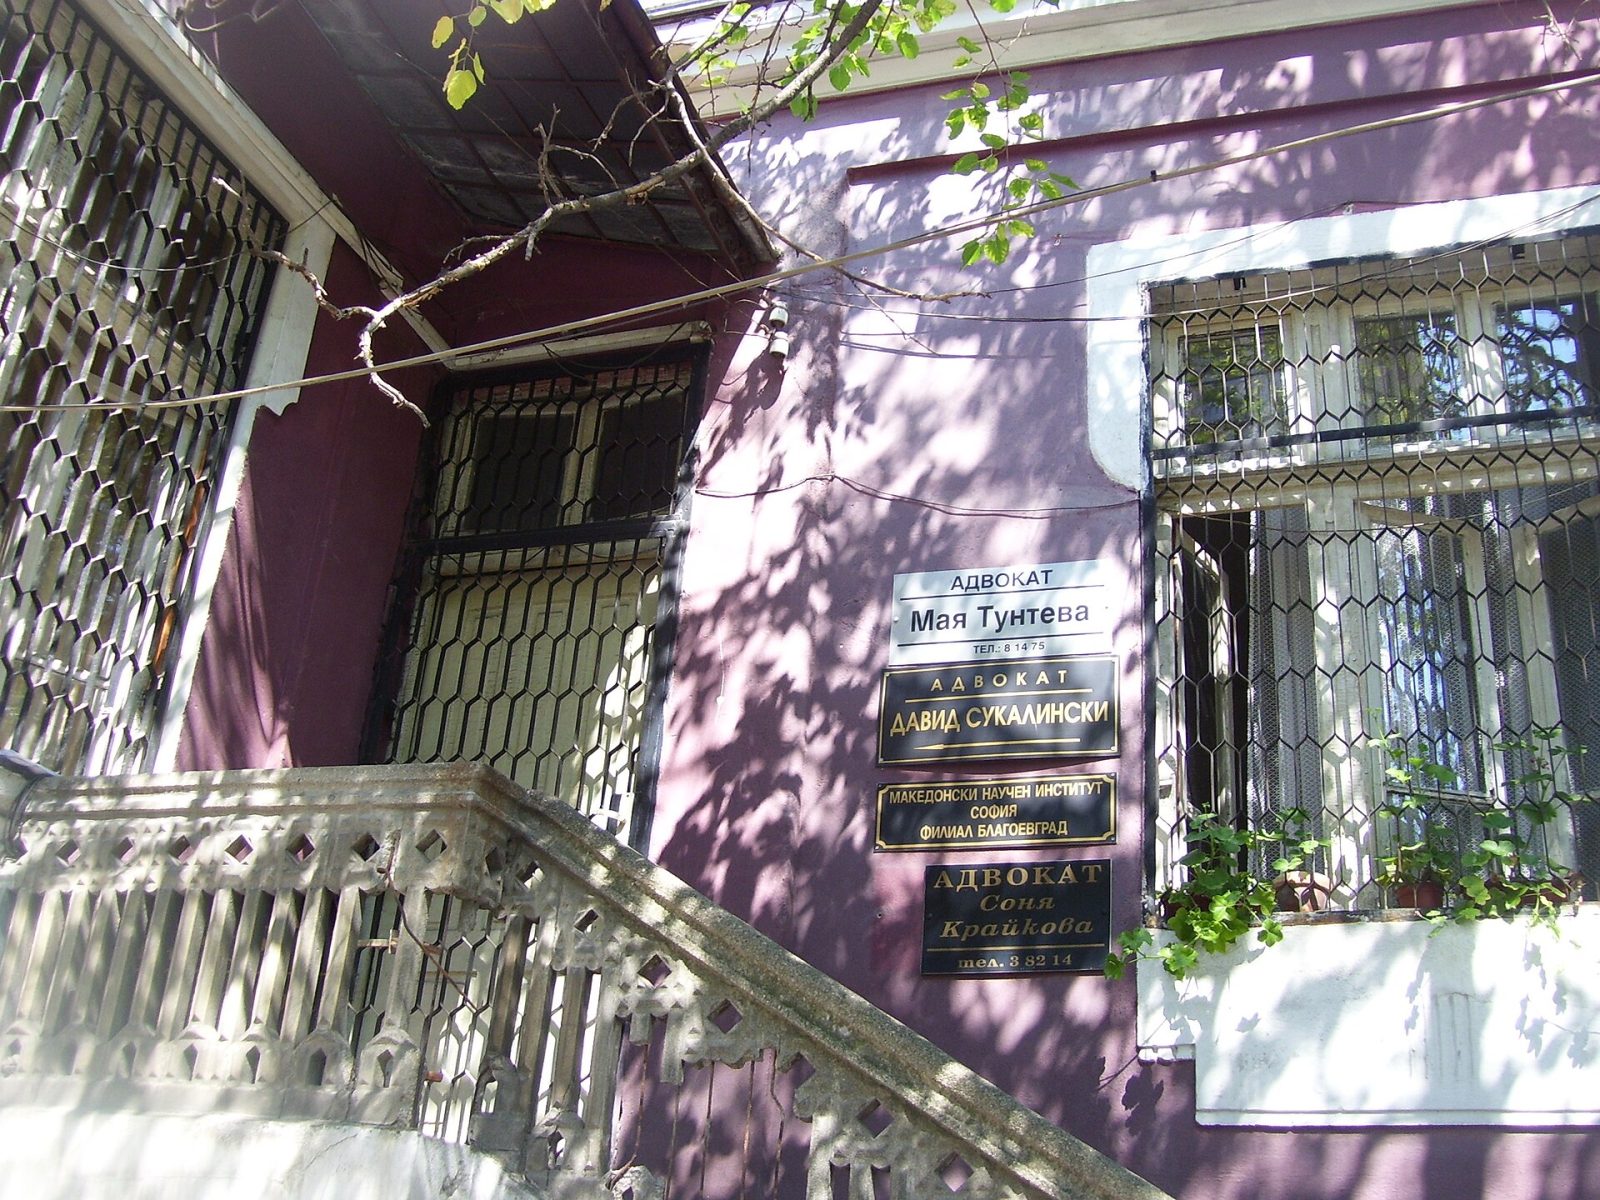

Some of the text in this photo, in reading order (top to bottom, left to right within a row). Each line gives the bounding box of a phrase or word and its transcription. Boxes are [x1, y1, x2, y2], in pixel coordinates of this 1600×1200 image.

[950, 569, 1053, 593] АДВОКАТ
[910, 604, 1089, 633] Мая Тунтева
[1003, 643, 1011, 653] 8
[1015, 642, 1028, 652] 14
[1031, 641, 1045, 651] 75
[931, 670, 1068, 692] АДВОКАТ
[890, 701, 1108, 737] ДАВИД СУКАЛИНСКИ
[889, 781, 1103, 804] МАКЕДОНСКИ НАУЧЕН ИНСТИТУТ
[970, 804, 1018, 820] СОФИЯ
[920, 820, 1068, 841] ФИЛИАЛ БЛАГОЕВГРАД
[933, 864, 1103, 893] АДВОКАТ
[979, 894, 1057, 912] Соня
[939, 917, 1094, 941] Крайкова
[958, 953, 1073, 969] тел. 3 82 14
